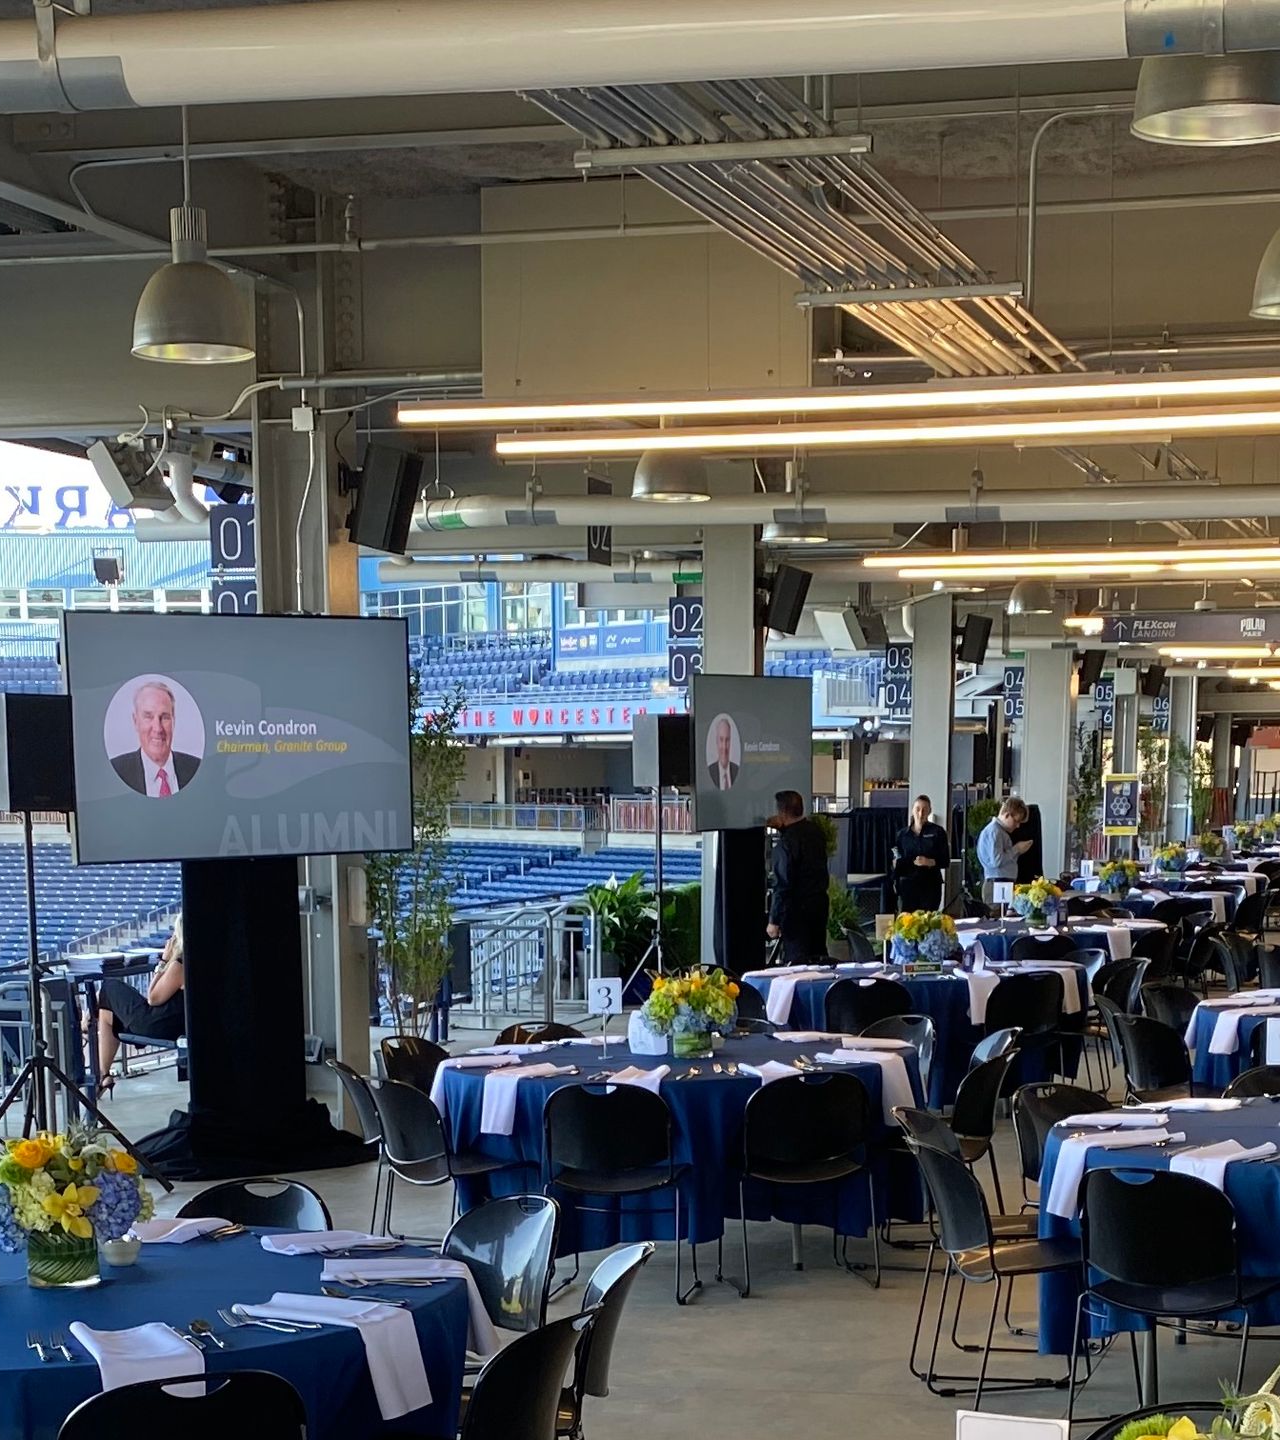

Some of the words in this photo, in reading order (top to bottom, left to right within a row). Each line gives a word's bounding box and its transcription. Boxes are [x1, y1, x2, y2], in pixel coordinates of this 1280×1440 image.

[672, 604, 703, 632] 02
[1240, 618, 1266, 632] POLAR
[887, 647, 912, 669] 03
[886, 684, 912, 705] 04
[1095, 685, 1113, 700] 05
[1004, 699, 1024, 716] 05
[1153, 697, 1169, 710] 06
[1103, 709, 1112, 723] 6
[215, 721, 254, 736] Kevin
[258, 720, 317, 736] Condron
[217, 741, 271, 754] Chairman,
[274, 740, 314, 752] Granite
[316, 740, 348, 753] Group
[220, 810, 397, 855] ALUMNI
[597, 986, 612, 1009] 3
